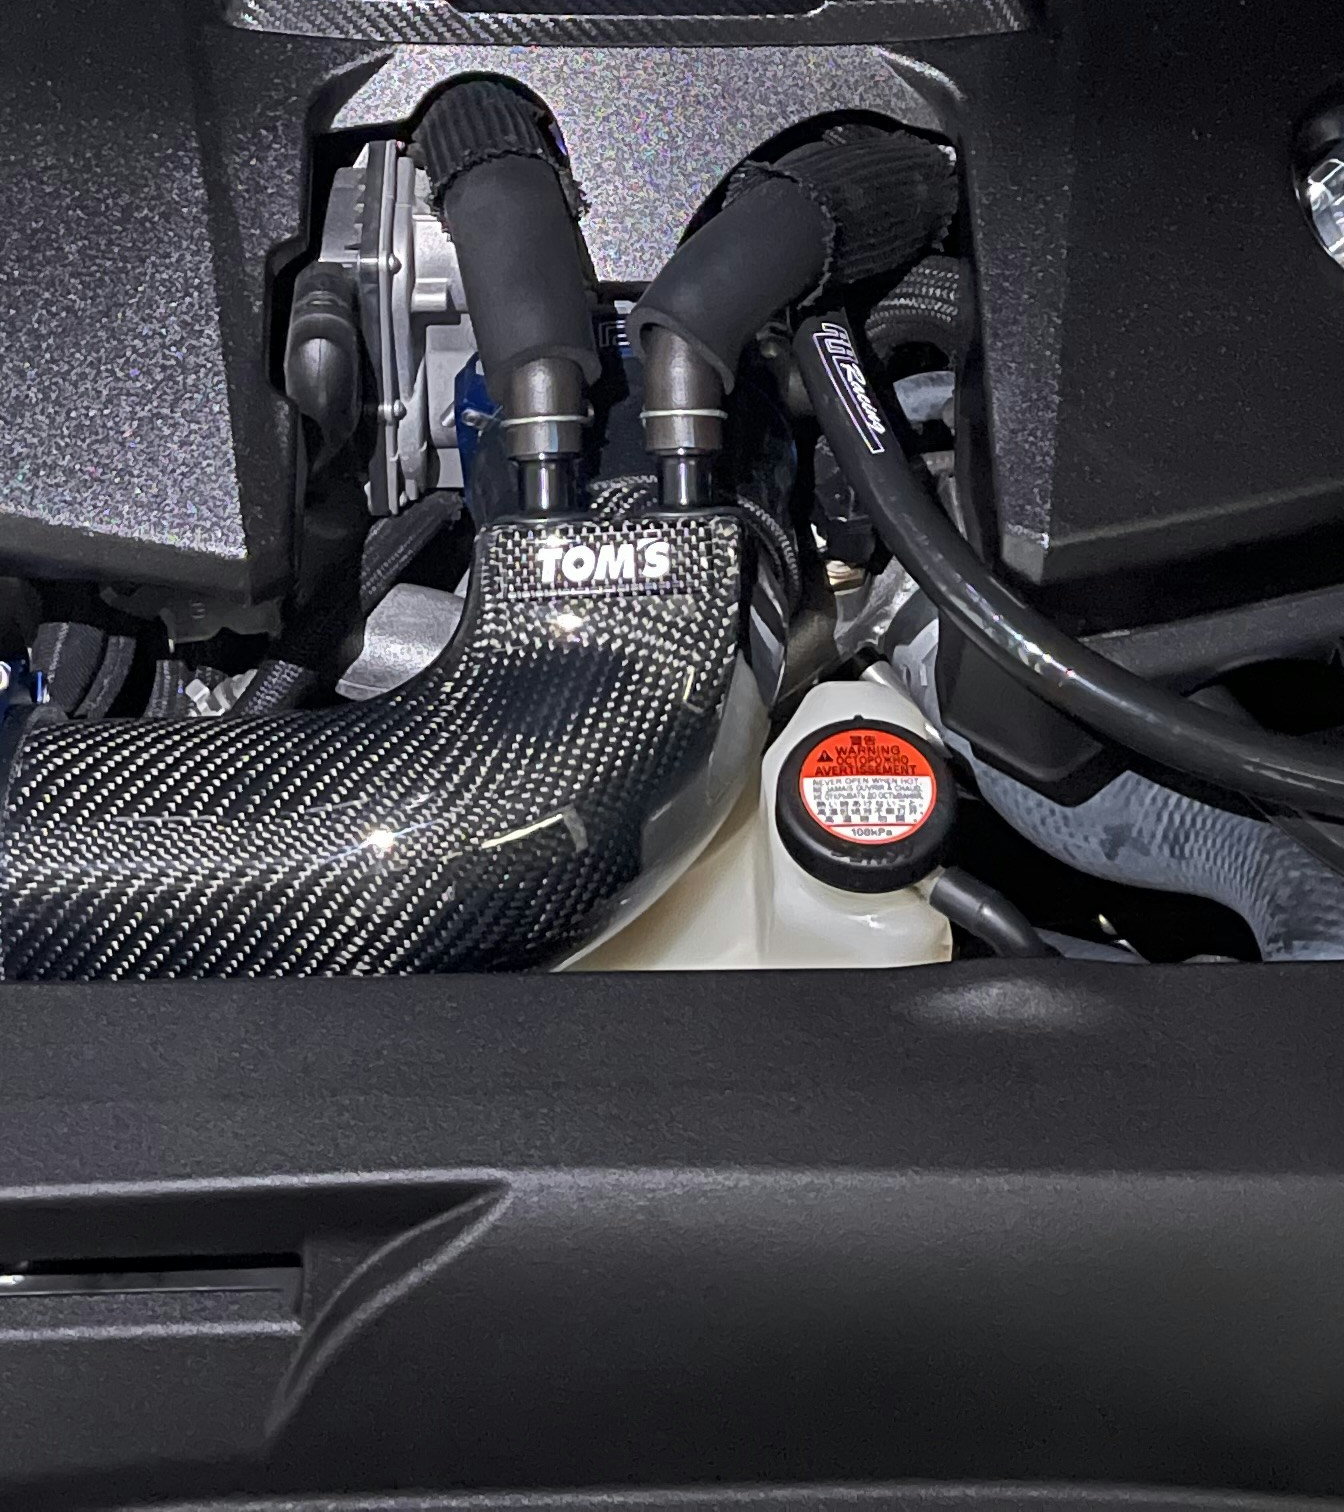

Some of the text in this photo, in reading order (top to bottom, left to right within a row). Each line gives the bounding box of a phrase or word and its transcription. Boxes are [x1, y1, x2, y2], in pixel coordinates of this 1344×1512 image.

[537, 537, 671, 583] TOM'S
[835, 745, 900, 755] WARNING
[815, 765, 917, 776] AVERTISSEMENT
[851, 828, 893, 837] 108kPa
